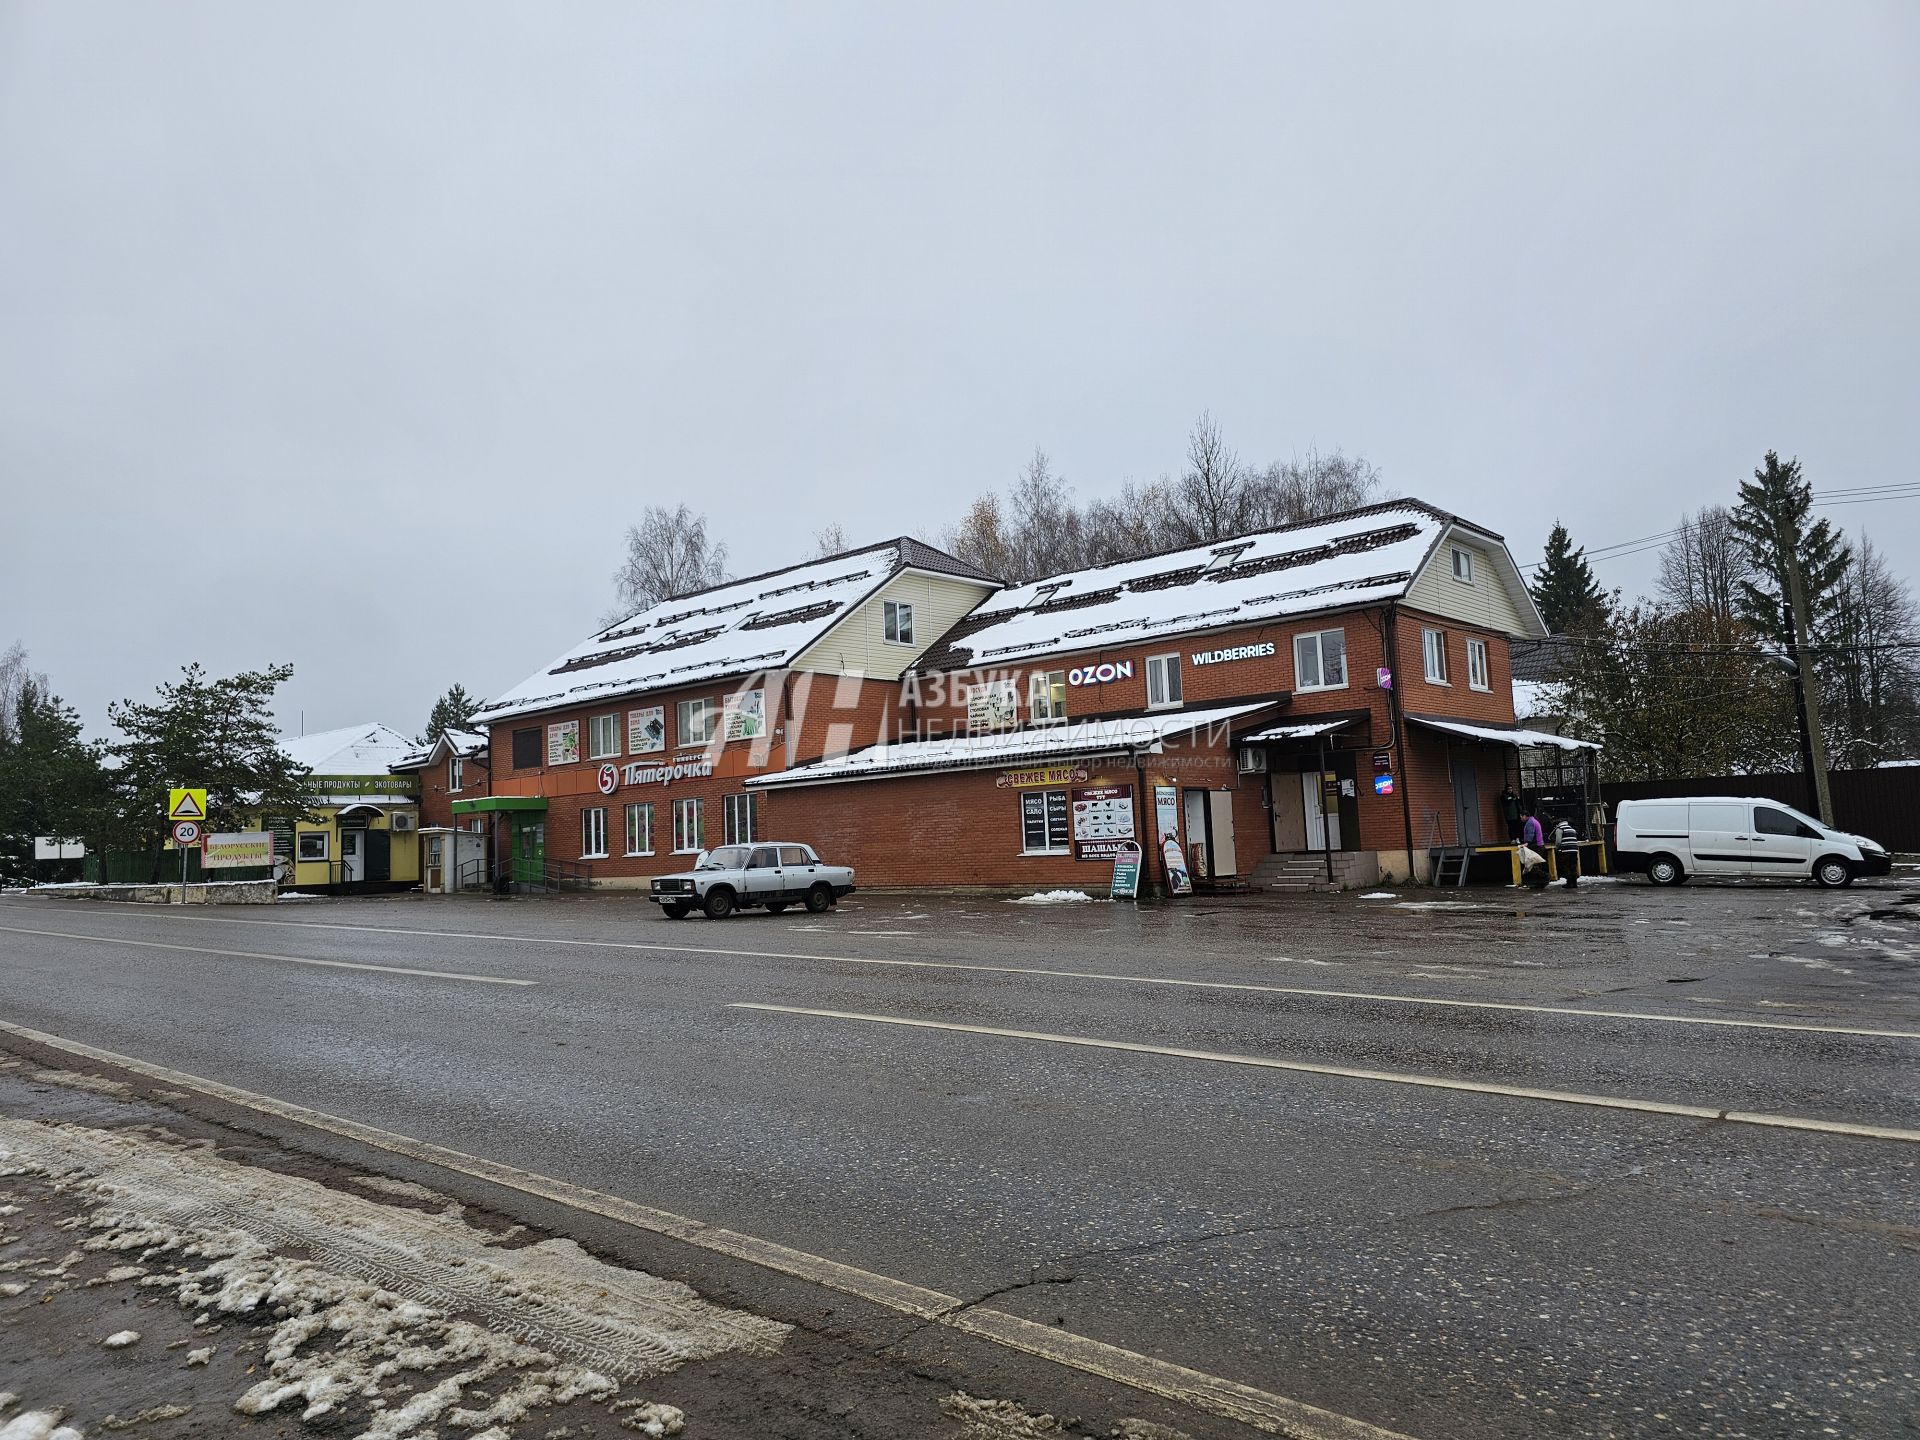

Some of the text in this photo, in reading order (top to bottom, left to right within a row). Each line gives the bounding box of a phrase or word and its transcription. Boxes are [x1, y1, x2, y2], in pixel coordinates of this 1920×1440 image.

[1192, 643, 1275, 666] WILDBERRIES
[1068, 661, 1134, 687] OZON
[1007, 769, 1076, 784] СВЕЖЕЕ МЯСО
[324, 781, 360, 789] ПРОДУКТЫ
[1157, 797, 1175, 806] МЯСО
[179, 827, 195, 837] 20
[213, 853, 262, 861] ПРОДУКТЫ
